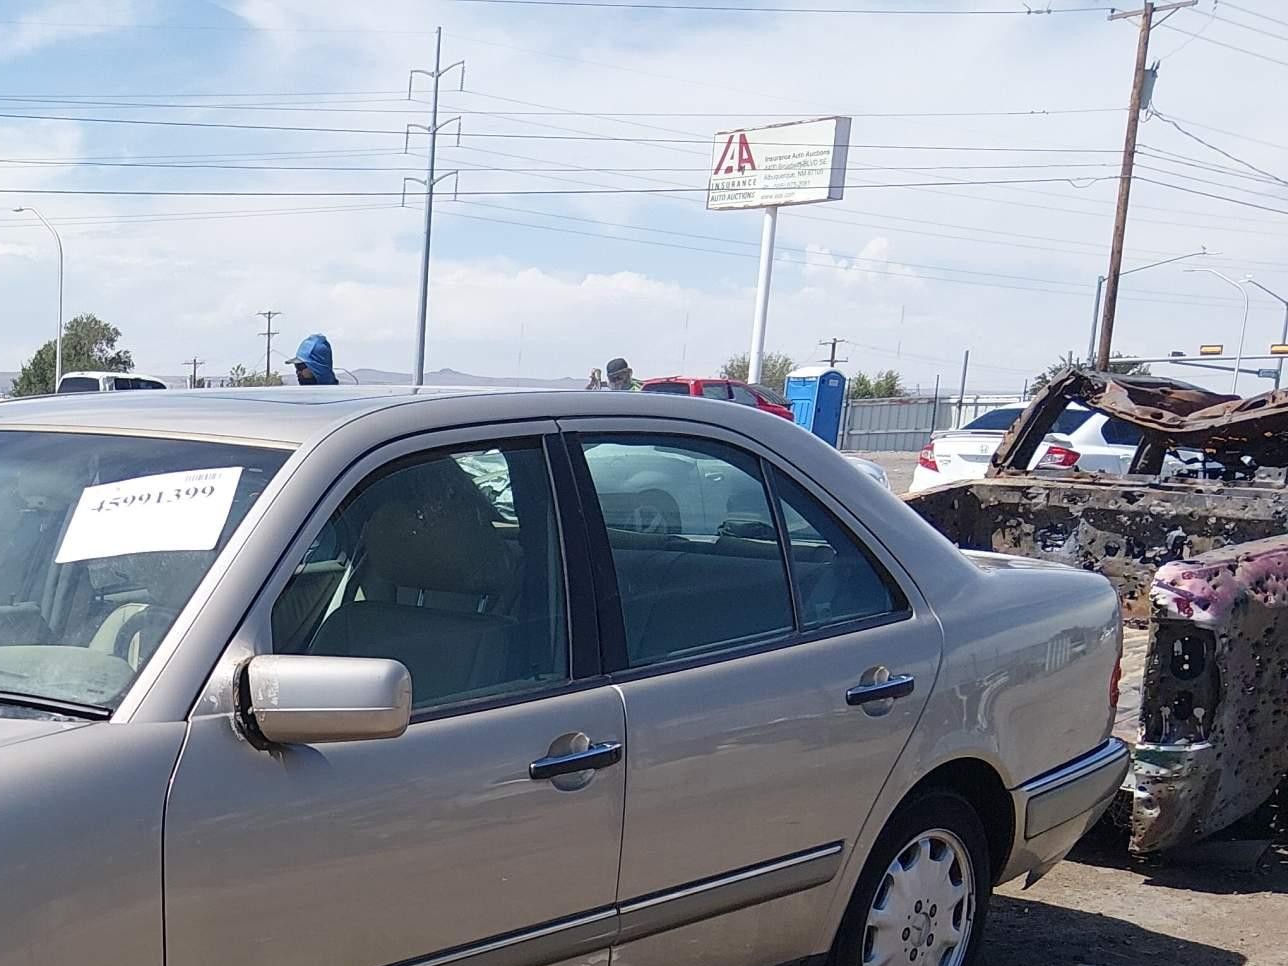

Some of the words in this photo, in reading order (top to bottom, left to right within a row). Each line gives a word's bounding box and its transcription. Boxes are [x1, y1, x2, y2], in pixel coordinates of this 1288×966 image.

[806, 149, 830, 157] Auctions
[711, 178, 757, 190] INSURANCE
[710, 193, 726, 202] AUTO
[726, 191, 756, 201] AUCTIONS
[90, 485, 216, 512] 45991399
